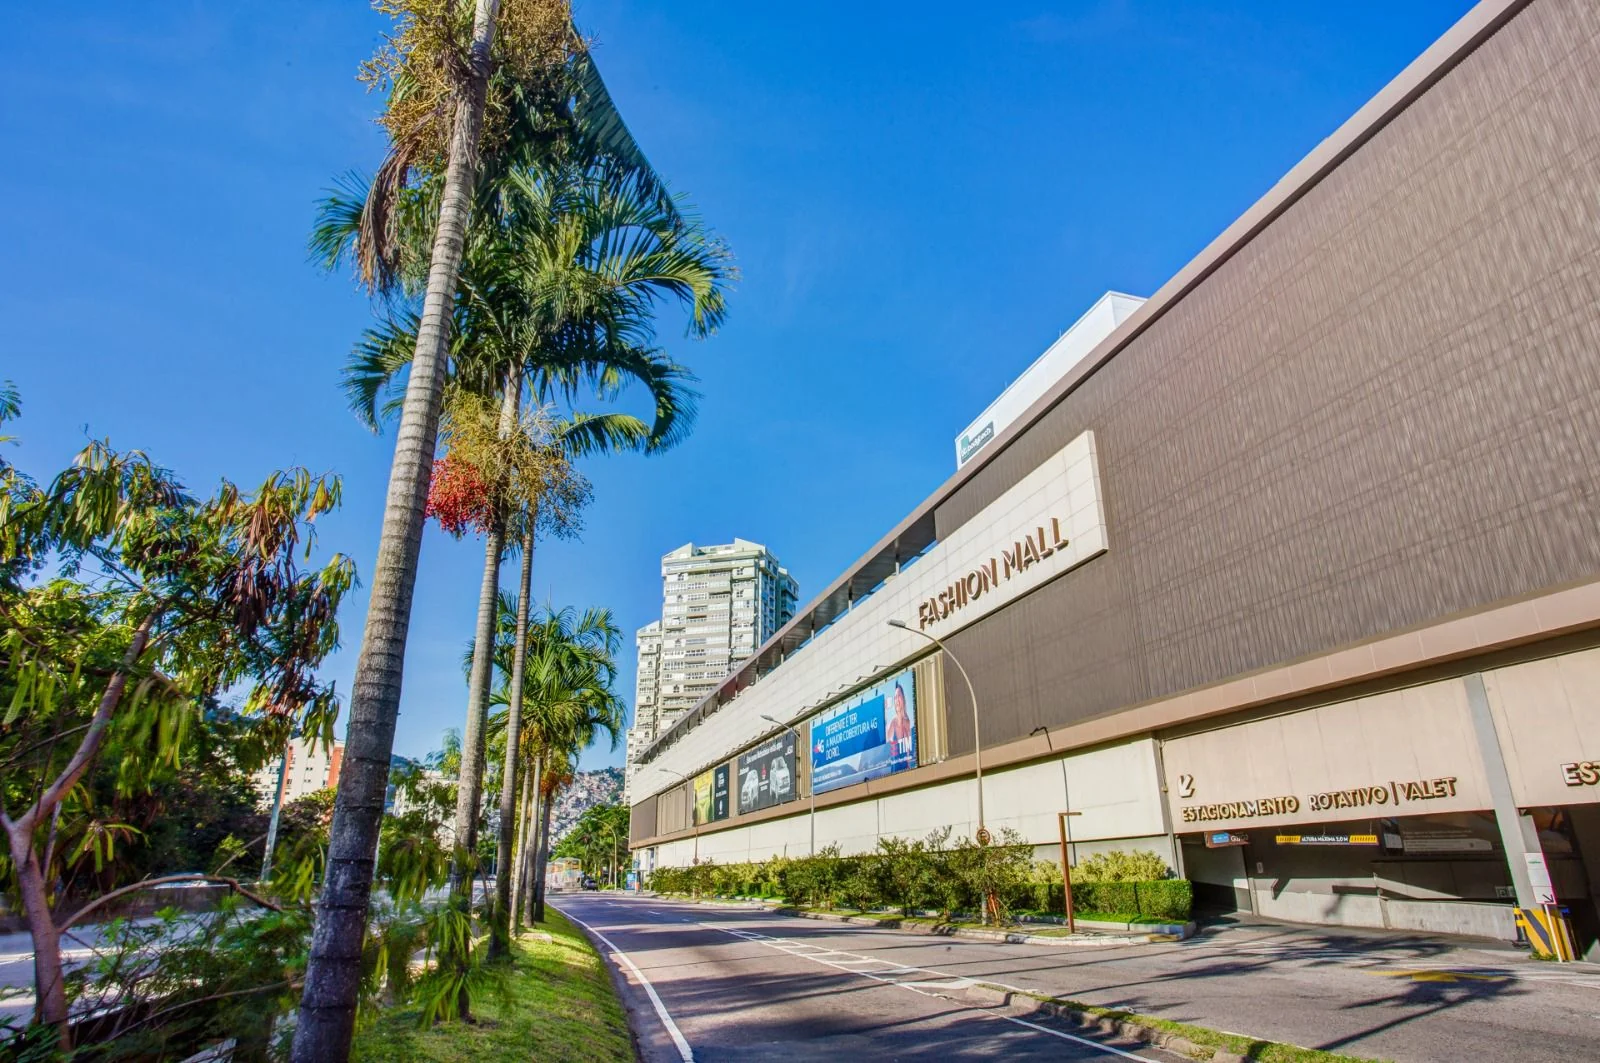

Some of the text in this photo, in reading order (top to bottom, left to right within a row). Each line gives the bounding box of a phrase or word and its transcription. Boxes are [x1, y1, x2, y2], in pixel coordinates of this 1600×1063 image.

[918, 517, 1069, 631] FASHION MALL
[843, 721, 870, 741] COBERTURA
[871, 717, 878, 729] 4G
[897, 736, 912, 754] TIM
[1181, 795, 1300, 822] ESTACIONAMENTO
[1308, 786, 1388, 811] ROTATIVO
[1399, 777, 1457, 801] VALET
